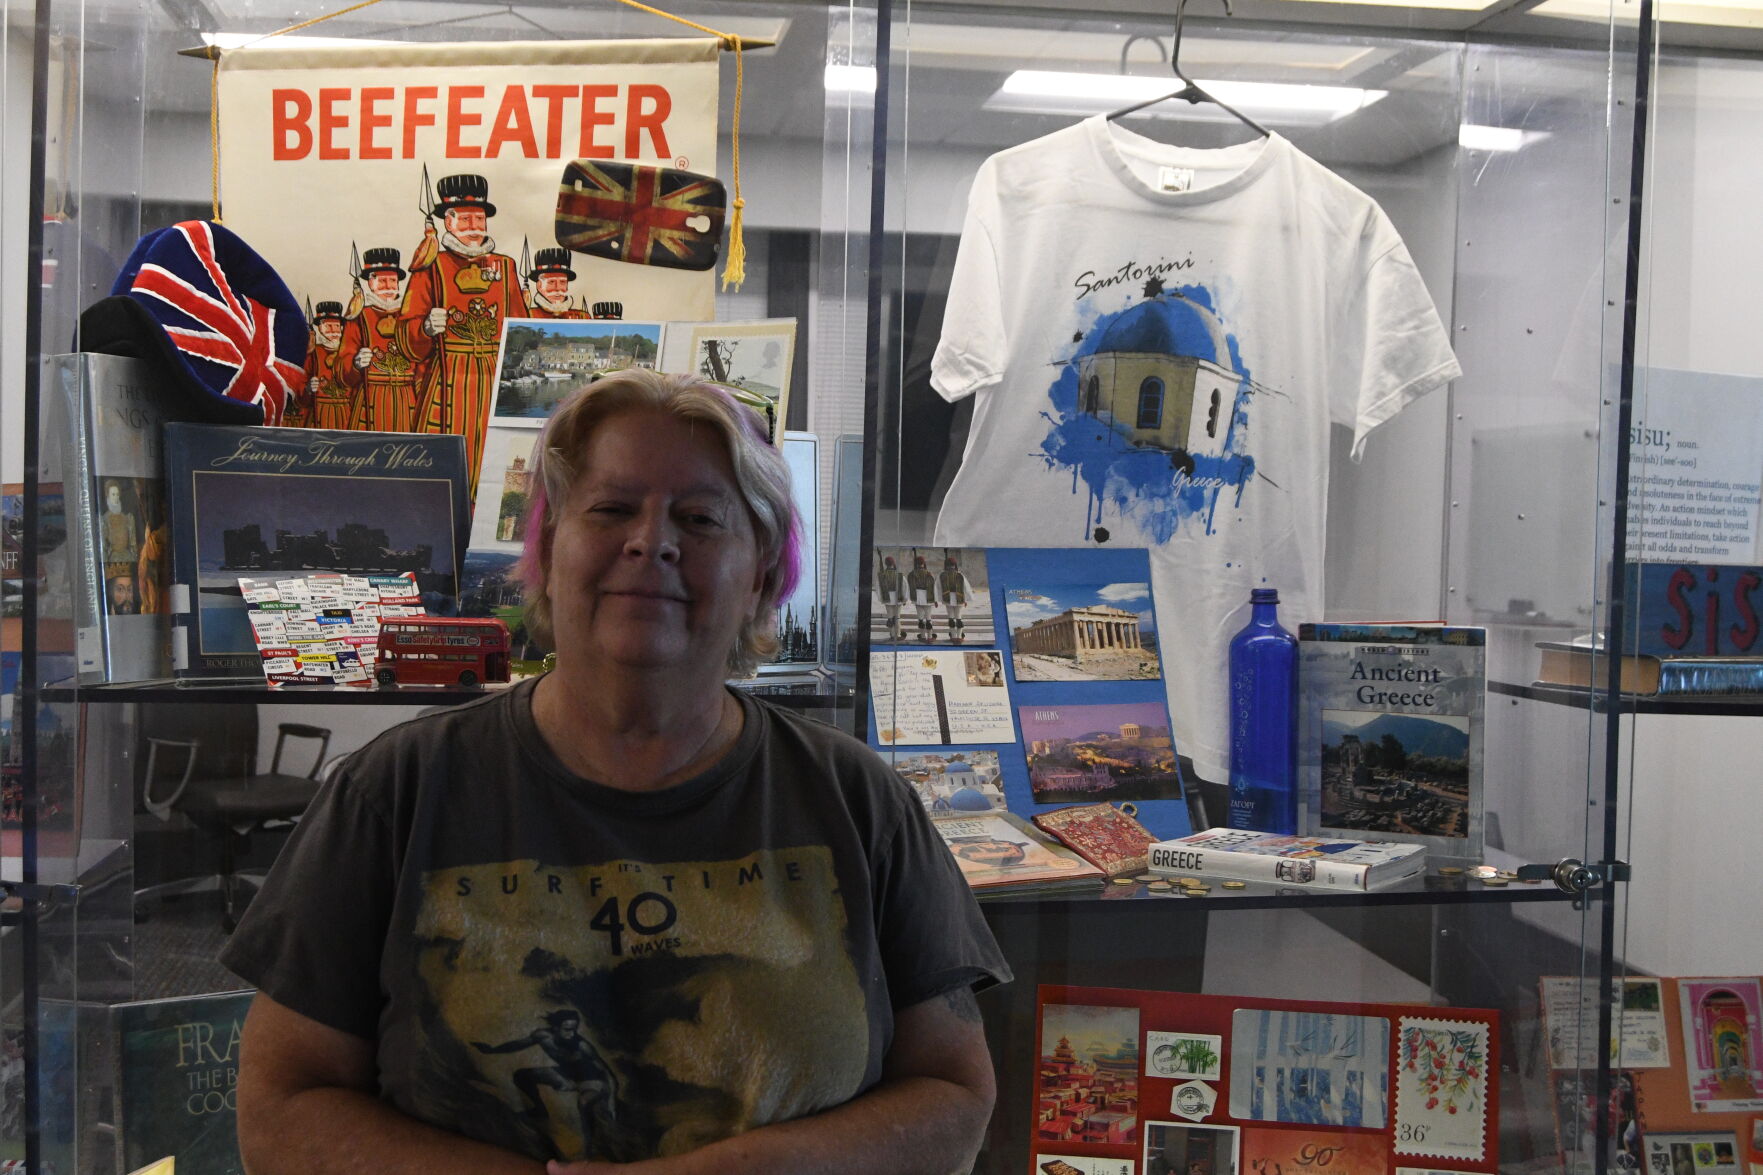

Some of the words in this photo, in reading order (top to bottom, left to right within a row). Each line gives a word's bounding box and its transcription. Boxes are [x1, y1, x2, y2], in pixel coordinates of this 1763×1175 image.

[272, 84, 672, 161] BEEFEATER
[1074, 251, 1195, 300] Santorini
[211, 436, 298, 473] Journey
[299, 440, 379, 475] Through
[383, 442, 434, 470] Wales
[1677, 477, 1730, 490] determination,
[1686, 491, 1693, 500] in
[1695, 492, 1707, 501] the
[1708, 493, 1725, 502] face
[1659, 503, 1670, 512] An
[1672, 505, 1695, 514] action
[1697, 506, 1725, 515] mindset
[1727, 508, 1747, 518] which
[1651, 516, 1692, 527] individuals
[1694, 519, 1702, 527] to
[1703, 519, 1721, 529] reach
[1724, 521, 1749, 532] beyond
[1669, 530, 1711, 542] limitations,
[1713, 533, 1727, 542] take
[1729, 534, 1750, 543] action
[1647, 544, 1657, 552] all
[1658, 544, 1677, 553] odds
[1679, 545, 1692, 554] and
[1694, 546, 1728, 556] transform
[396, 634, 412, 644] Esso
[1350, 661, 1441, 683] Ancient
[1356, 685, 1434, 707] Greece
[1033, 711, 1060, 720] ATHENS
[1153, 848, 1204, 871] GREECE
[457, 874, 602, 897] SURF
[663, 862, 802, 893] TIME
[591, 892, 677, 956] 40
[631, 937, 681, 955] WAVES
[186, 1069, 222, 1091] THE
